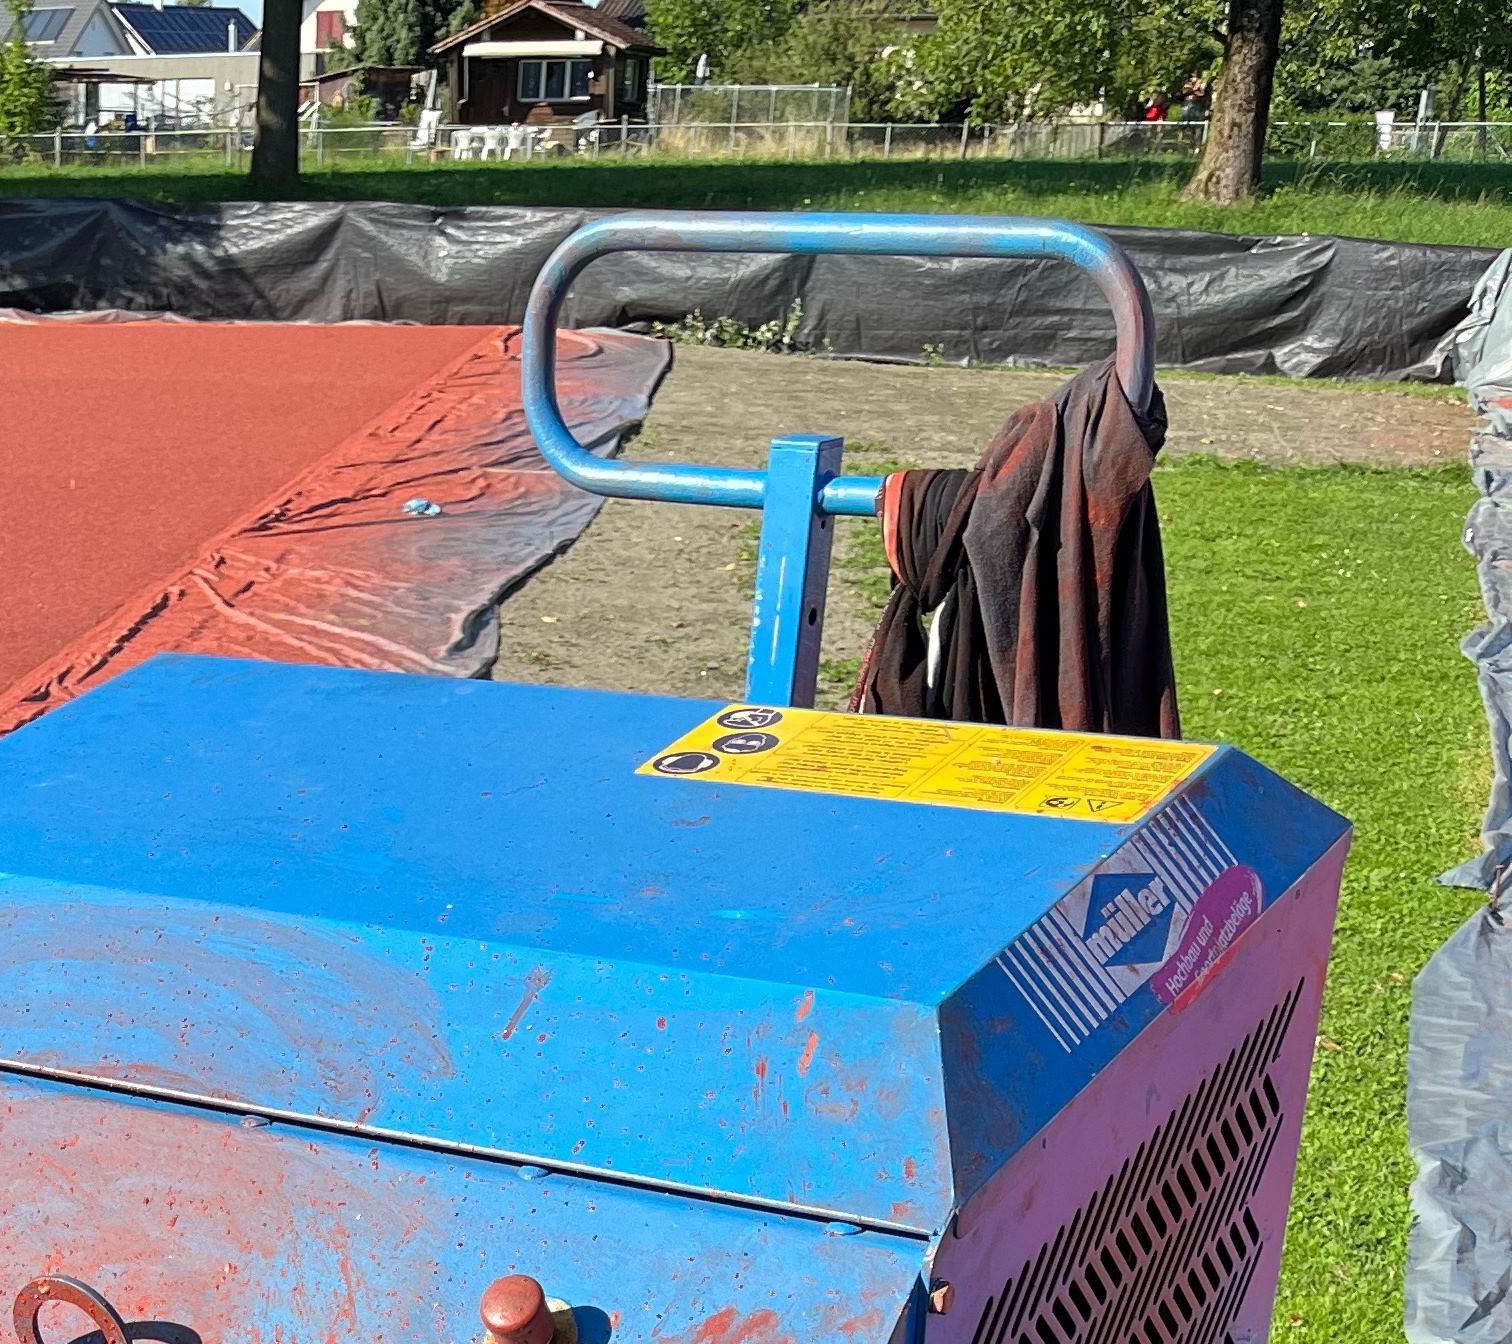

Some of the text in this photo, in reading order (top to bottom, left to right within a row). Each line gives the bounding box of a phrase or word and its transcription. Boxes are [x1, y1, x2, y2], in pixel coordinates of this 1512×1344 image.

[1085, 875, 1171, 965] müller
[1165, 914, 1214, 997] Hochbau und
